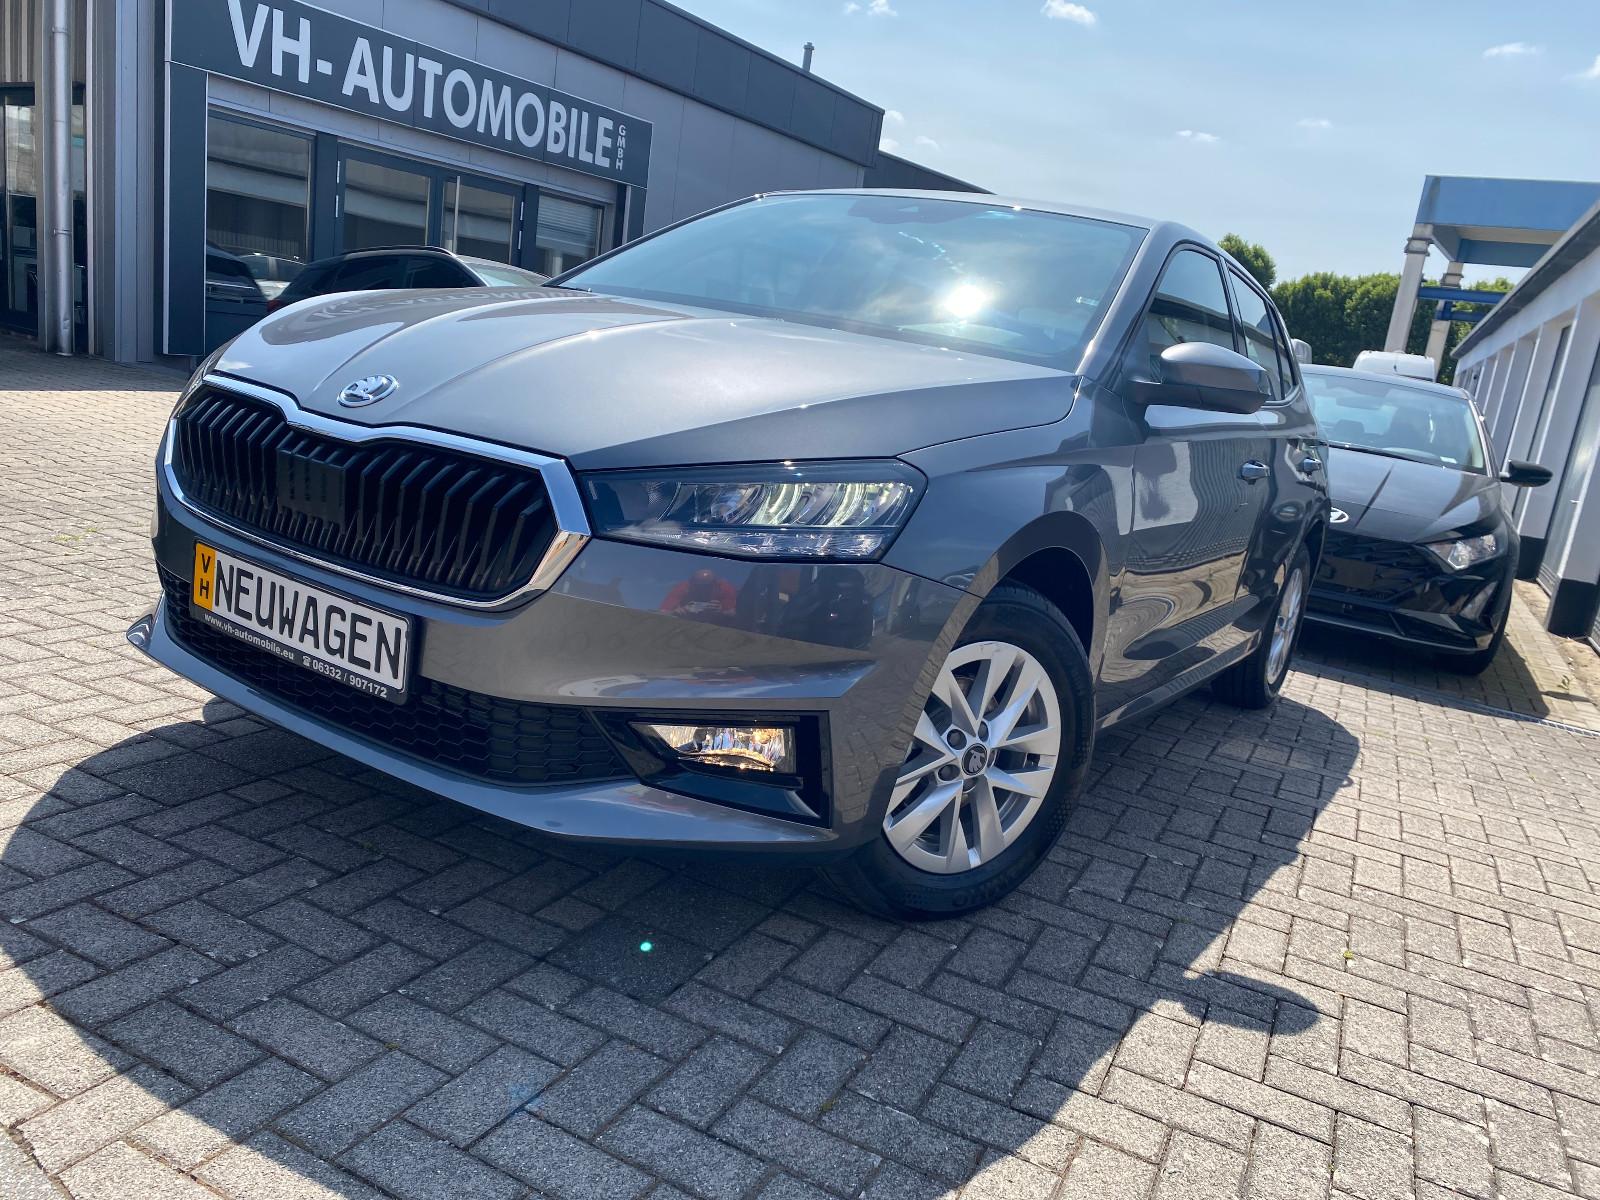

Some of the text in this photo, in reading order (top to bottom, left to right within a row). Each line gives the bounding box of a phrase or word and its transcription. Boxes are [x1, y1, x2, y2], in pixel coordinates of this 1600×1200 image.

[227, 0, 614, 169] VH- AUTOMOBILE
[616, 124, 626, 171] GMBH
[204, 613, 295, 661] www.vh-automobile.eu
[312, 660, 342, 680] 06332
[349, 674, 388, 699] 907172
[214, 559, 402, 680] NEUWAGEN
